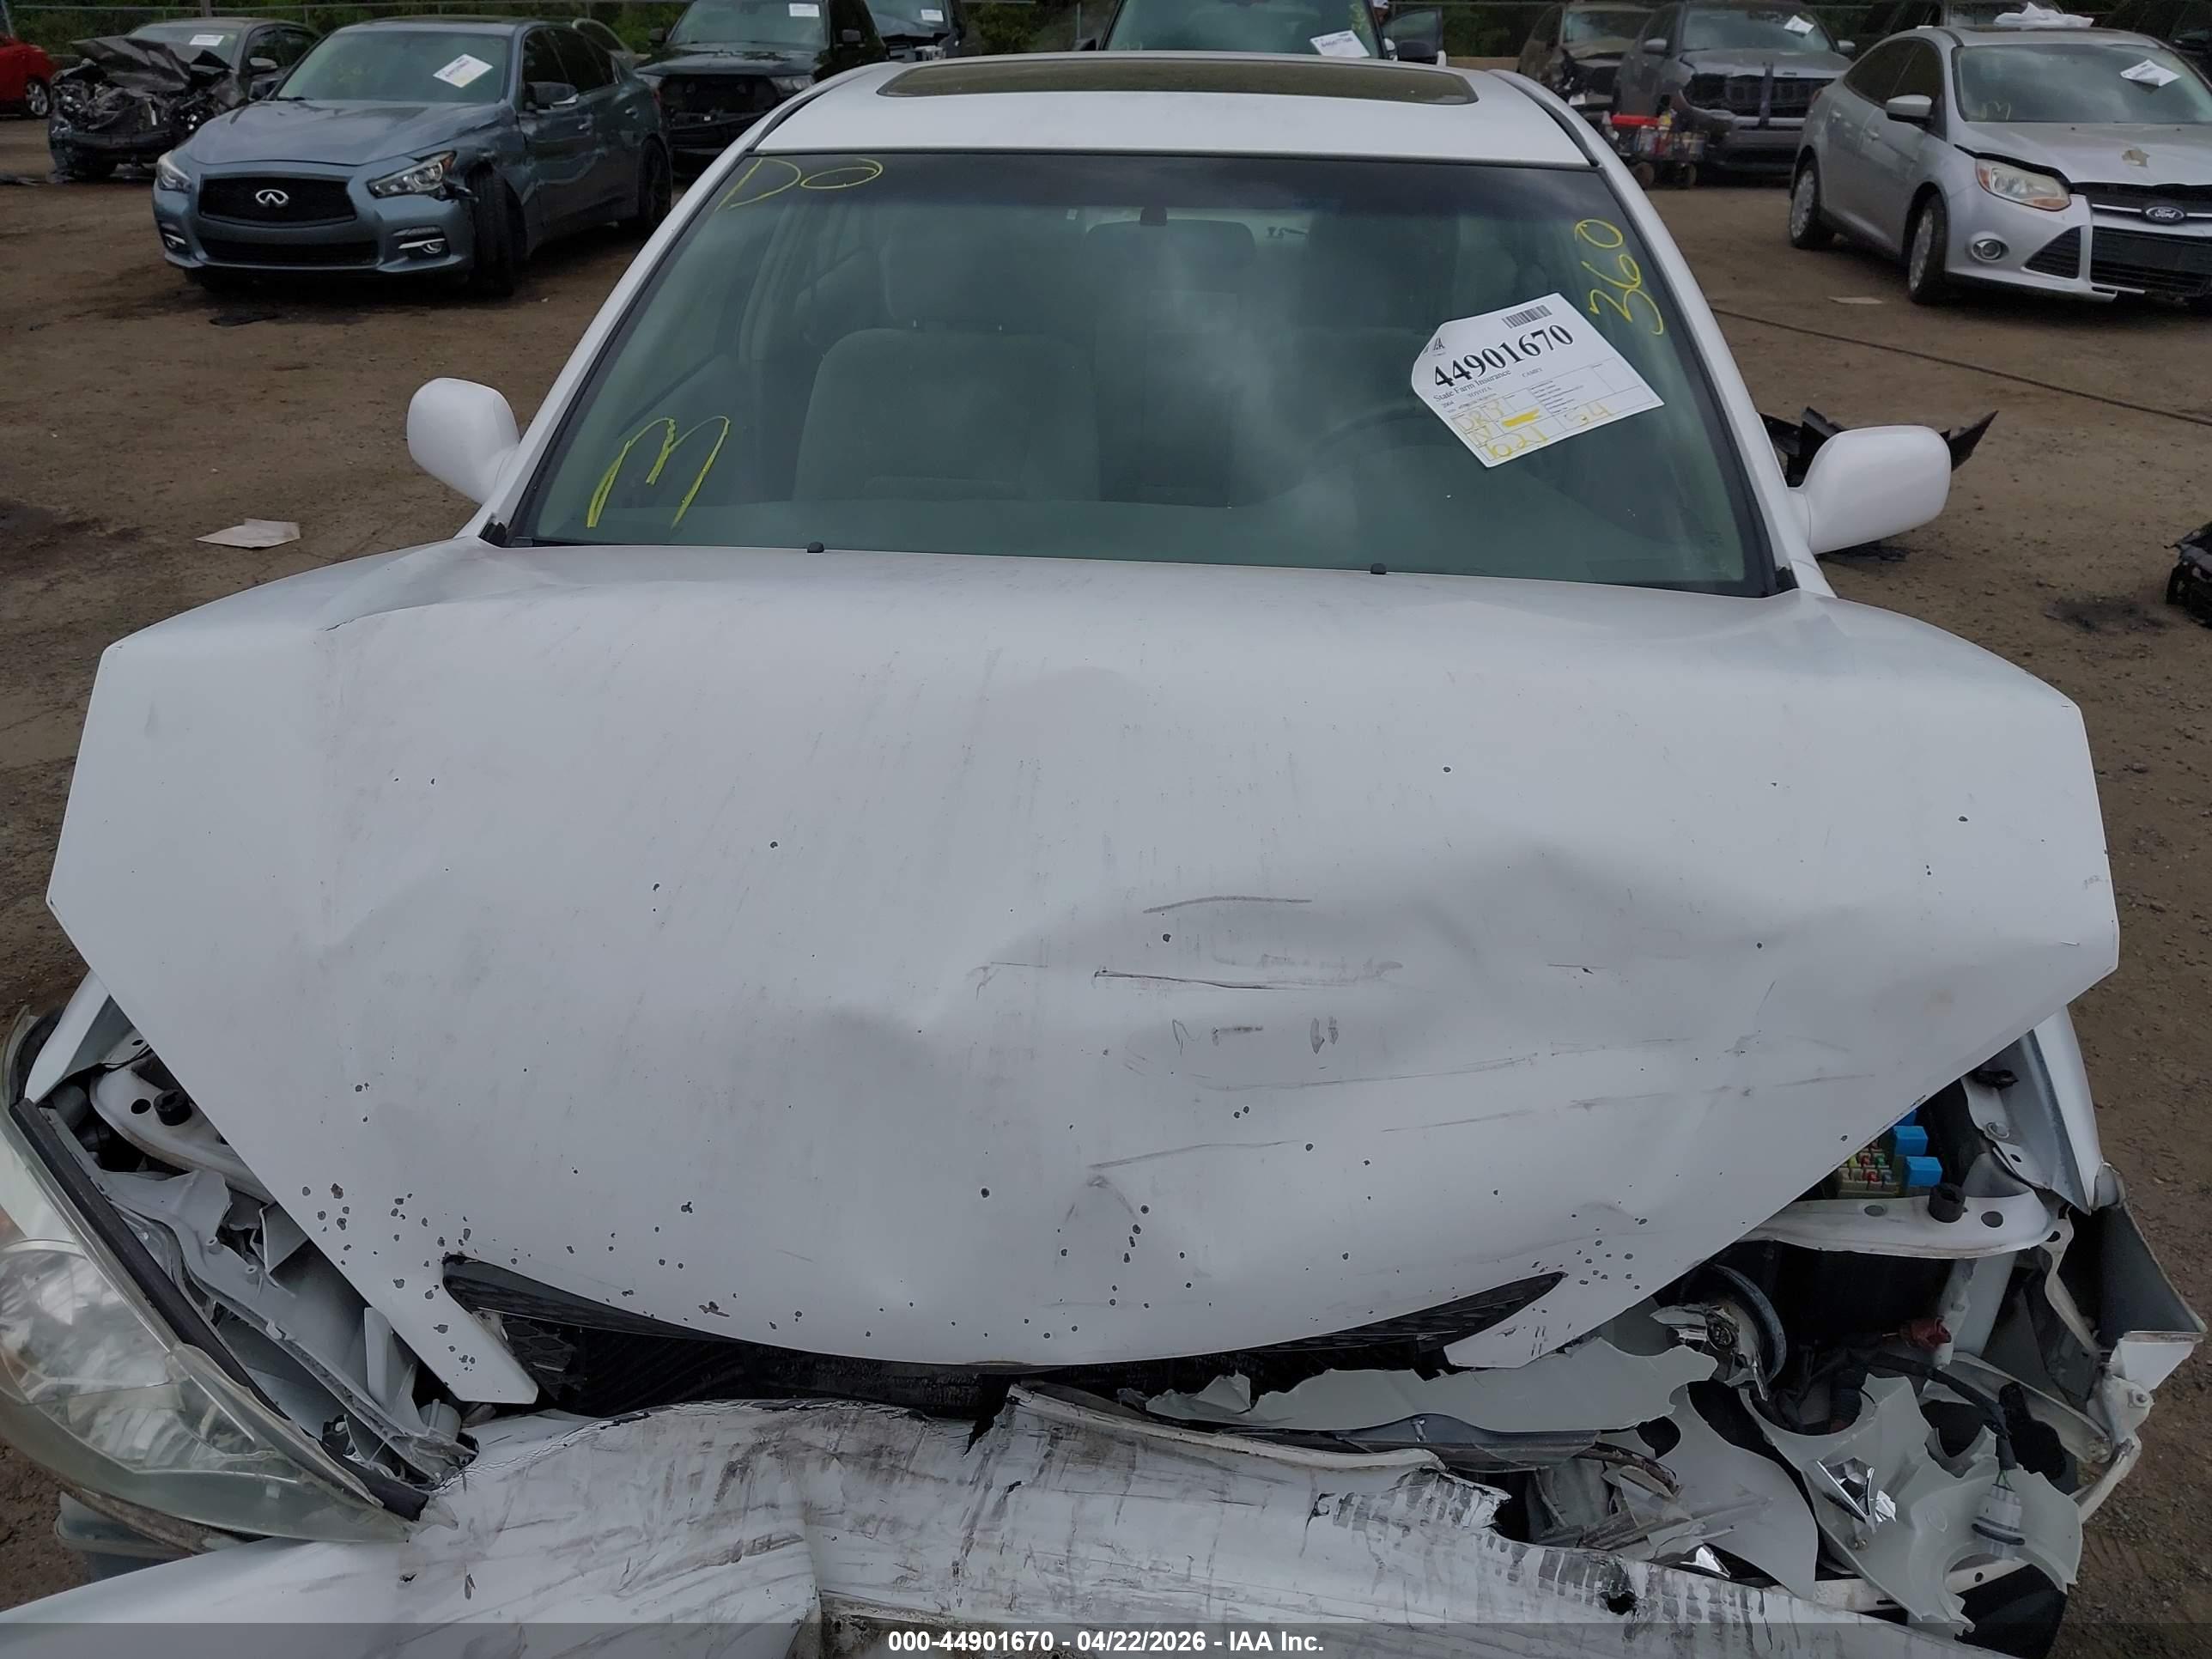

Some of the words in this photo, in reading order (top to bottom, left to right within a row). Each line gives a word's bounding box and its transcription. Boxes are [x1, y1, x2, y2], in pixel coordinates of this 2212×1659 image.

[1574, 218, 1664, 336] 360
[1433, 390, 1455, 403] State
[1454, 382, 1475, 395] Farm
[1474, 370, 1512, 388] Insurance
[1434, 325, 1574, 387] 44901670
